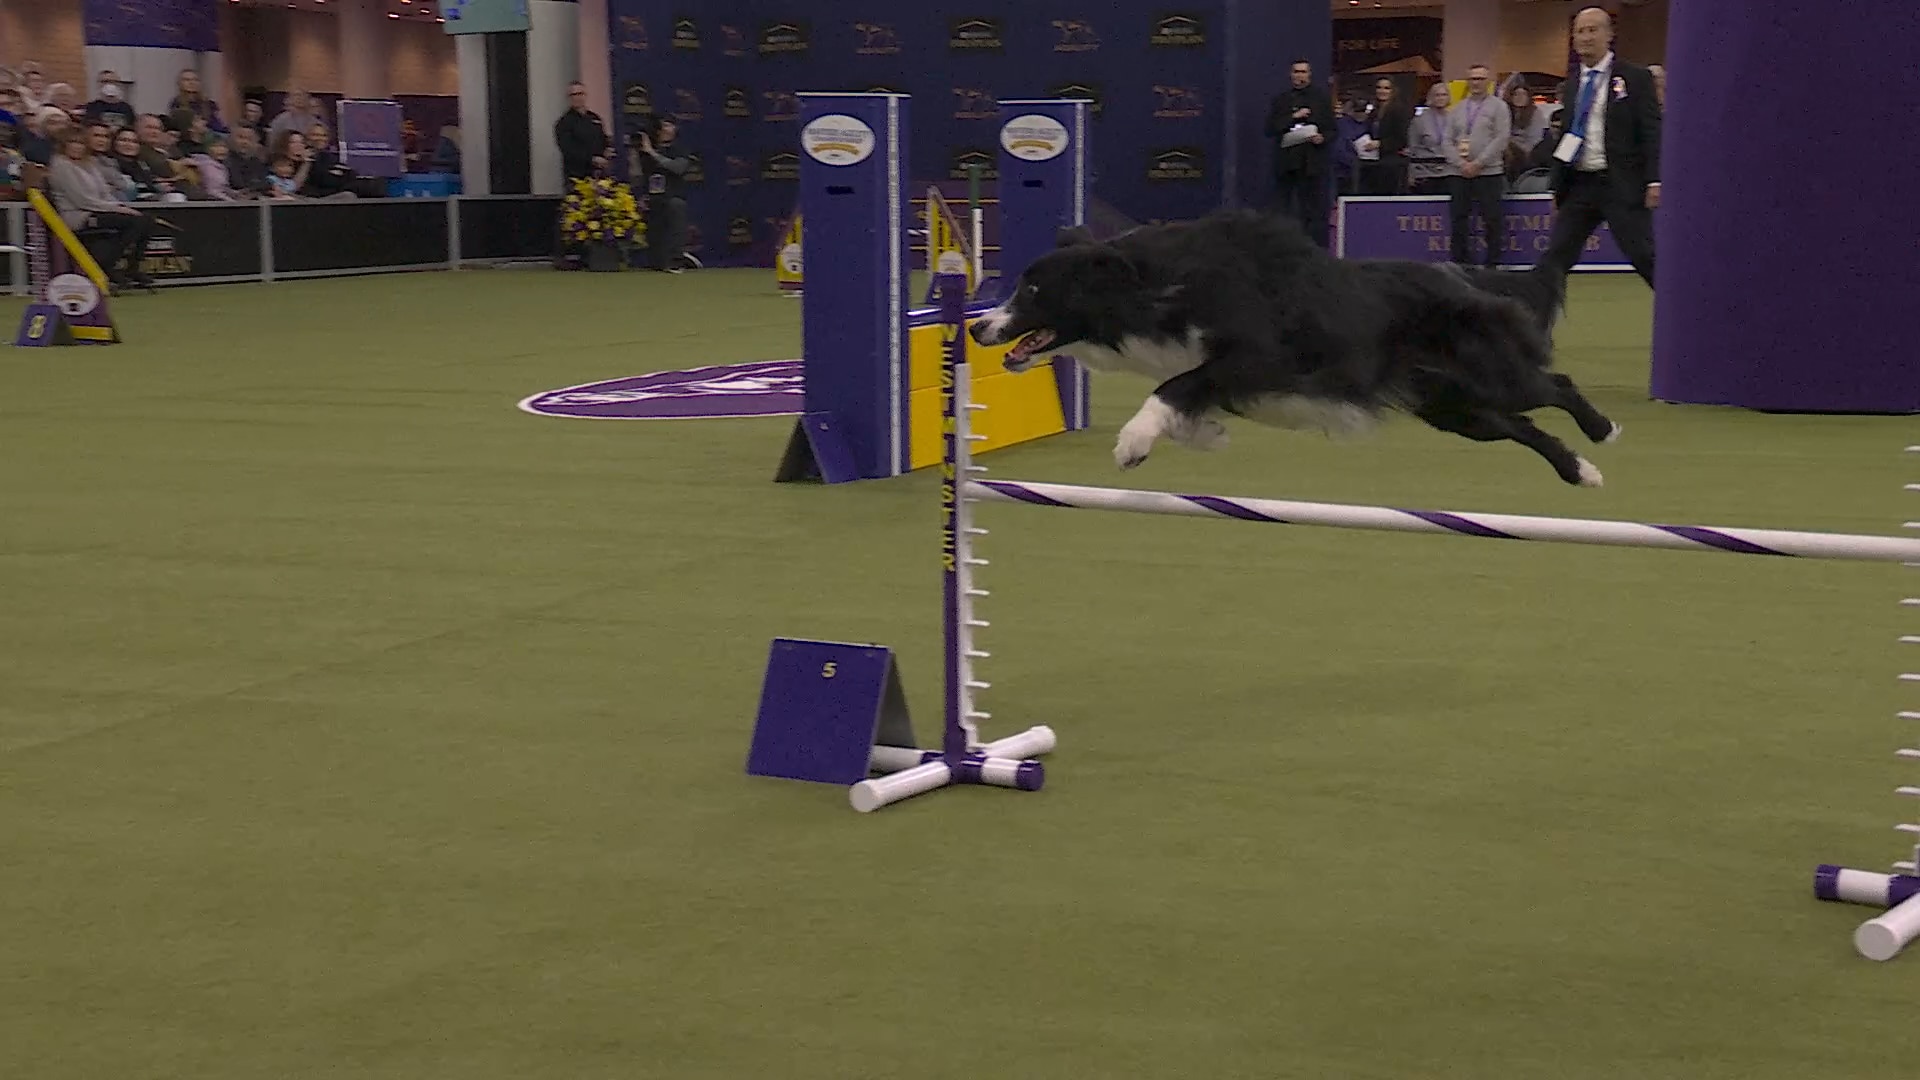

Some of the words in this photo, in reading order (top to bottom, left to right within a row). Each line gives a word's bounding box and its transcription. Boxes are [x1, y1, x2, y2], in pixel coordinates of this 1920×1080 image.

[1397, 216, 1442, 232] THE
[940, 322, 959, 573] WESTMINSTER
[821, 662, 838, 679] 5
